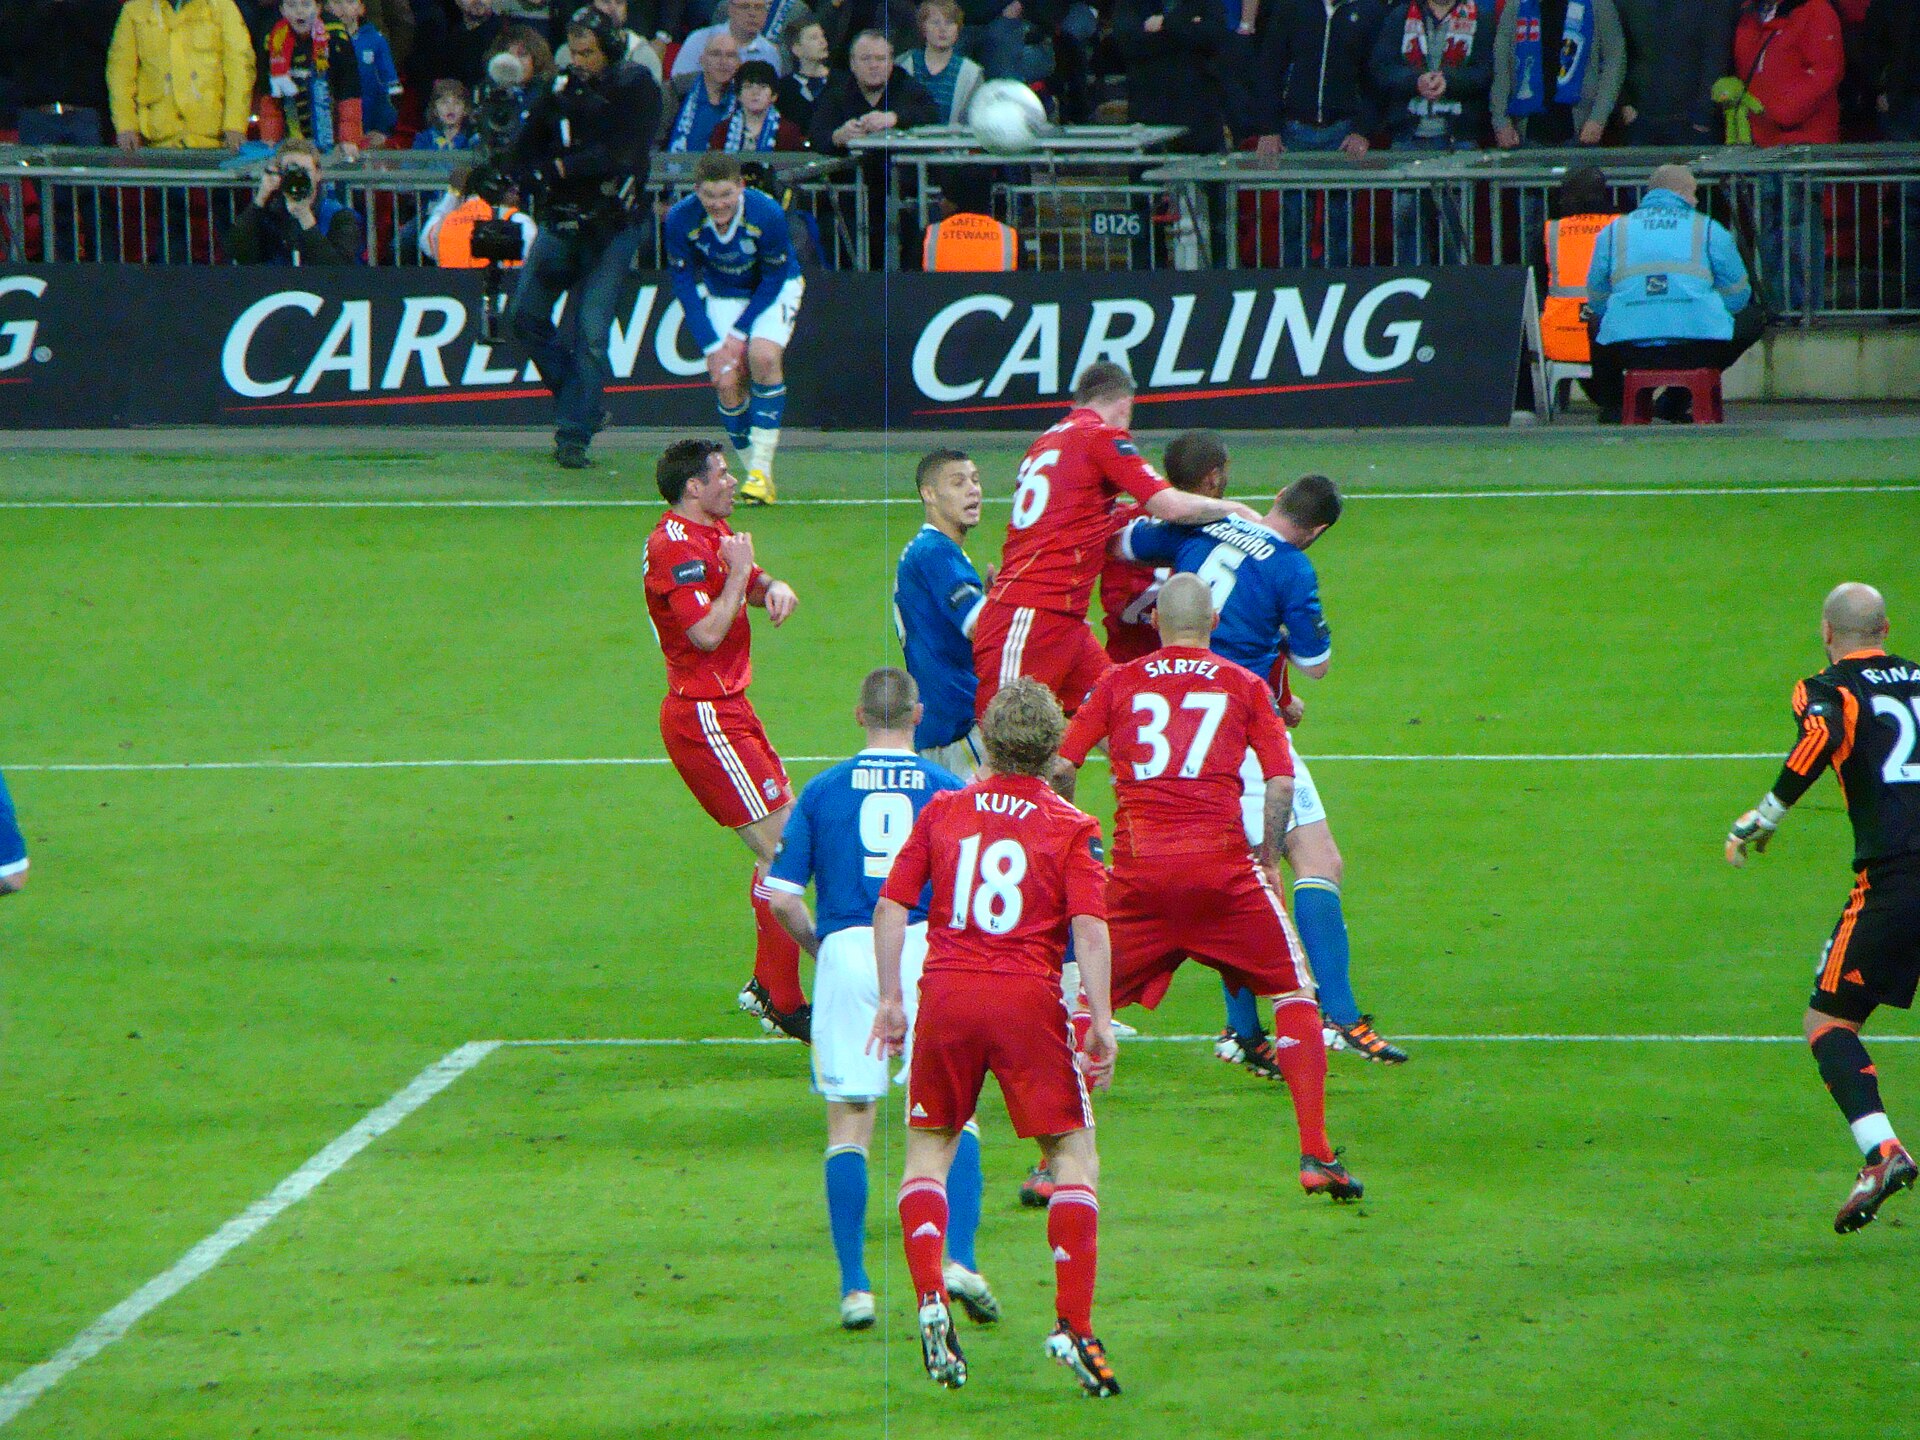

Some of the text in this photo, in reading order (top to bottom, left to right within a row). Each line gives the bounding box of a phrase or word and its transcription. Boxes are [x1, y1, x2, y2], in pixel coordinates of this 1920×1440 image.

[942, 229, 1000, 241] STEWARD
[1094, 213, 1140, 235] B126
[1643, 218, 1678, 230] TEAM
[912, 277, 1433, 402] CARLING
[1144, 658, 1219, 680] SKRTEL
[1131, 691, 1228, 780] 37
[1870, 694, 1920, 783] 2
[851, 768, 925, 790] MILLER
[975, 792, 1038, 820] KUYT
[859, 792, 913, 878] 9
[949, 832, 1028, 935] 18
